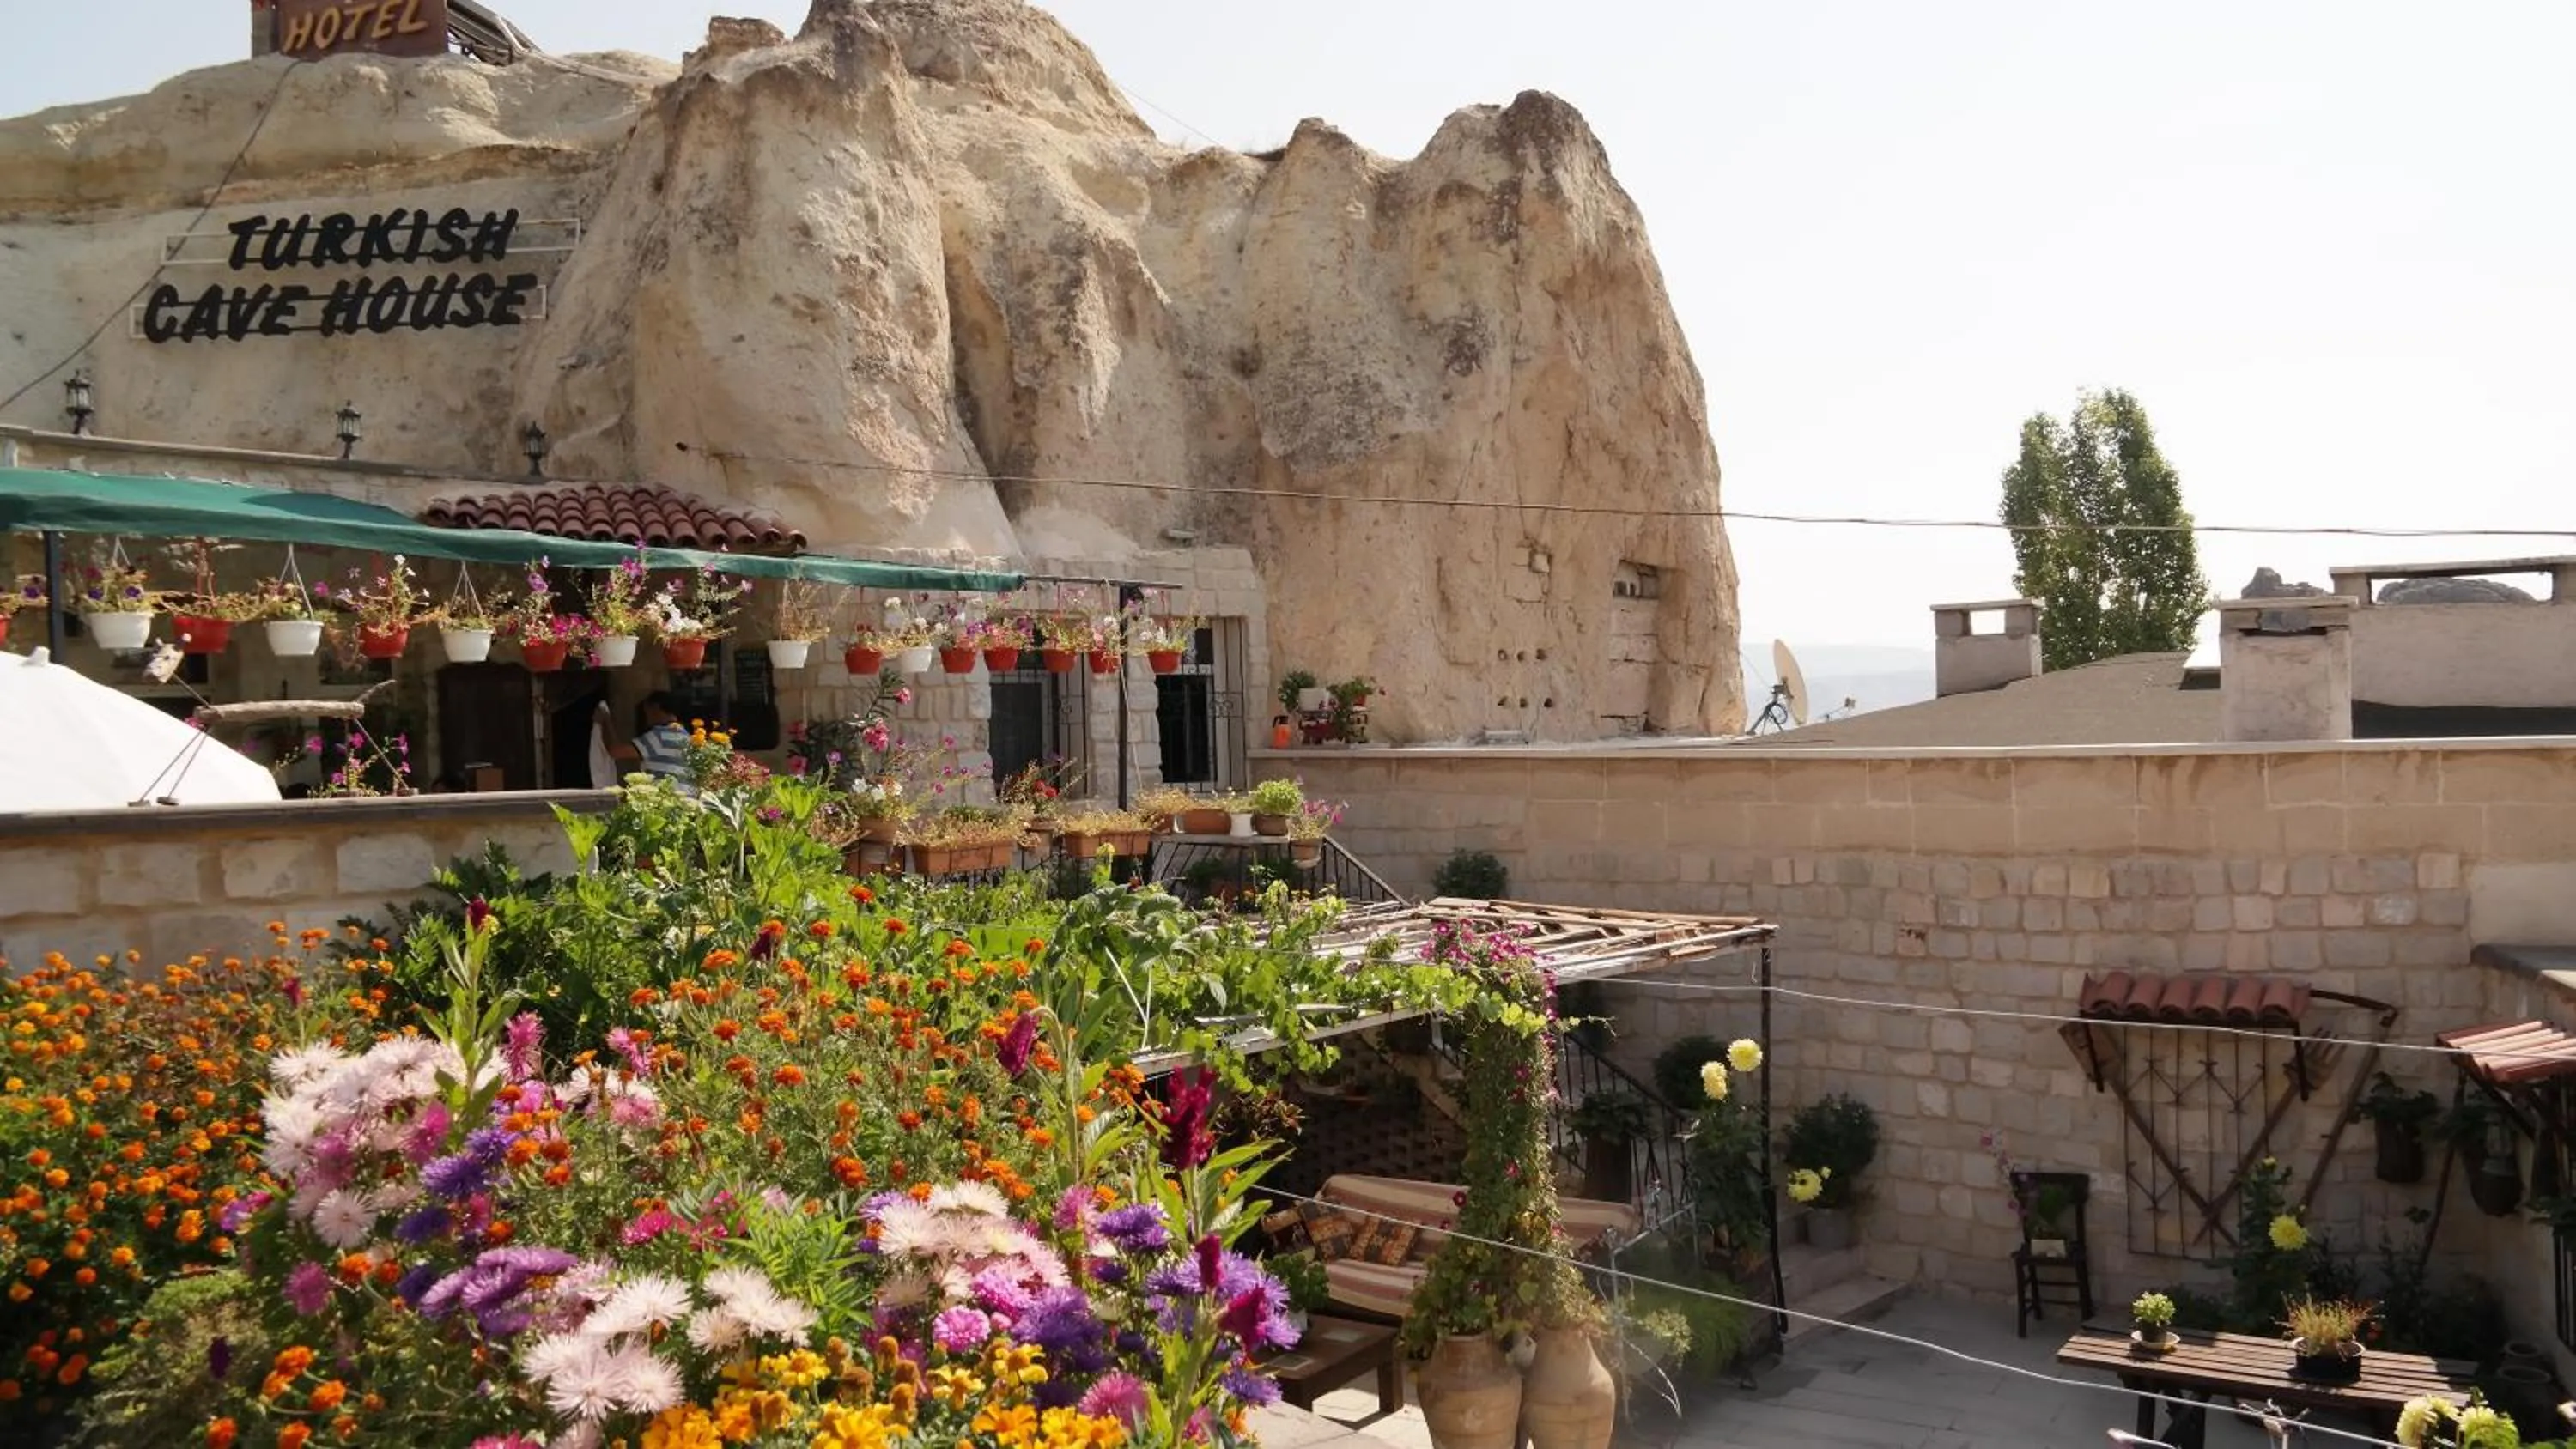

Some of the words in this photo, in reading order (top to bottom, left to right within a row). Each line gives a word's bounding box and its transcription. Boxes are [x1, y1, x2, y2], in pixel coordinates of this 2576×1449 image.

[282, 0, 428, 53] HOTEL
[228, 208, 519, 270] TURKISH
[143, 284, 310, 343] CAVE
[319, 272, 538, 335] HOUSE
